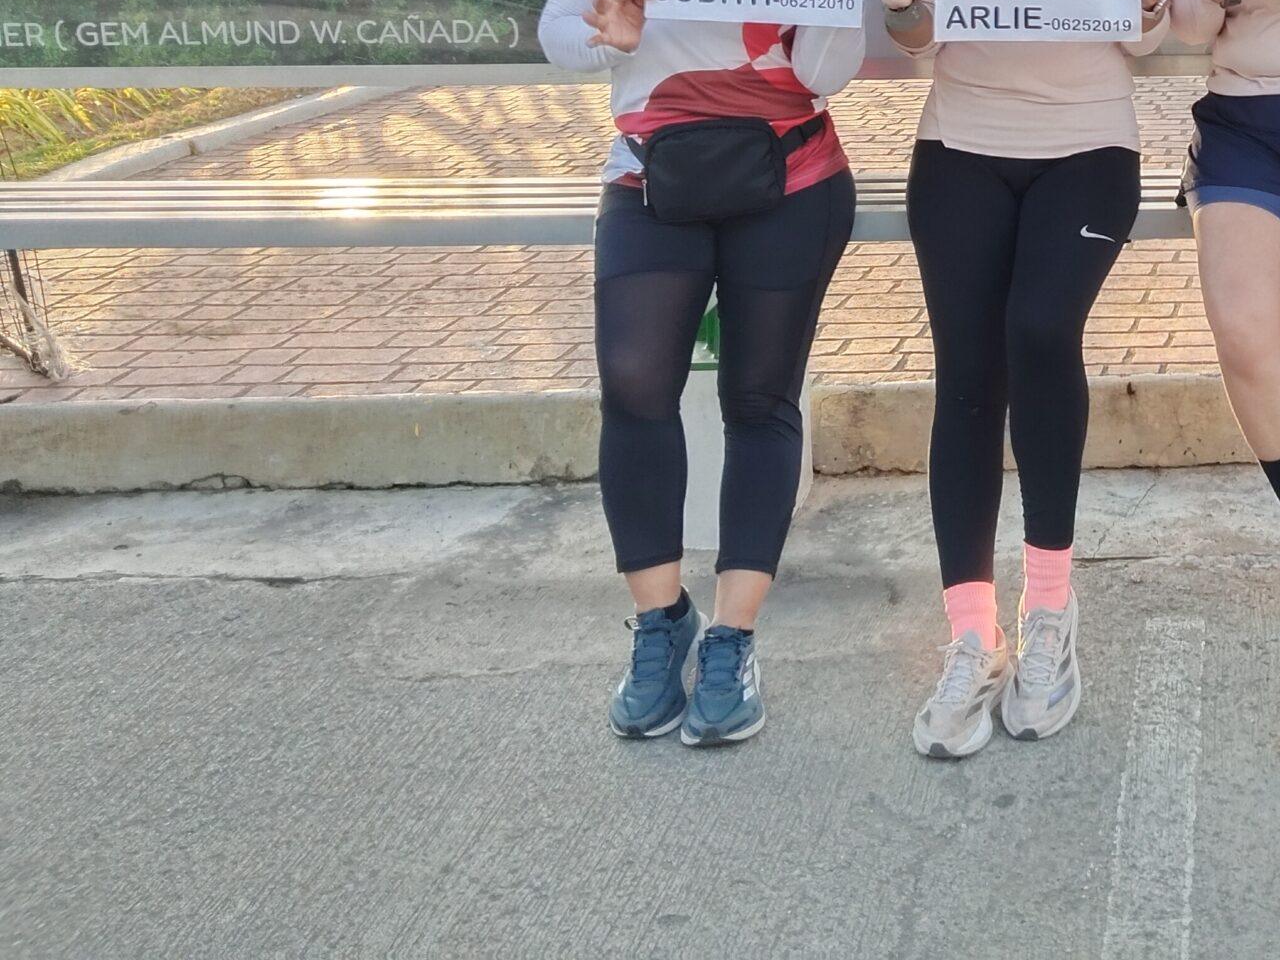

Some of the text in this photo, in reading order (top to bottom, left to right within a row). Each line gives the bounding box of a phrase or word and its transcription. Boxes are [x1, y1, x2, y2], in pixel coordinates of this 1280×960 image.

[0, 22, 45, 47] ER
[76, 21, 148, 46] GEM
[158, 20, 301, 46] ALMUND
[311, 20, 347, 46] W.
[356, 14, 499, 45] CAÑADA
[945, 5, 1132, 32] ARLIE-06252019
